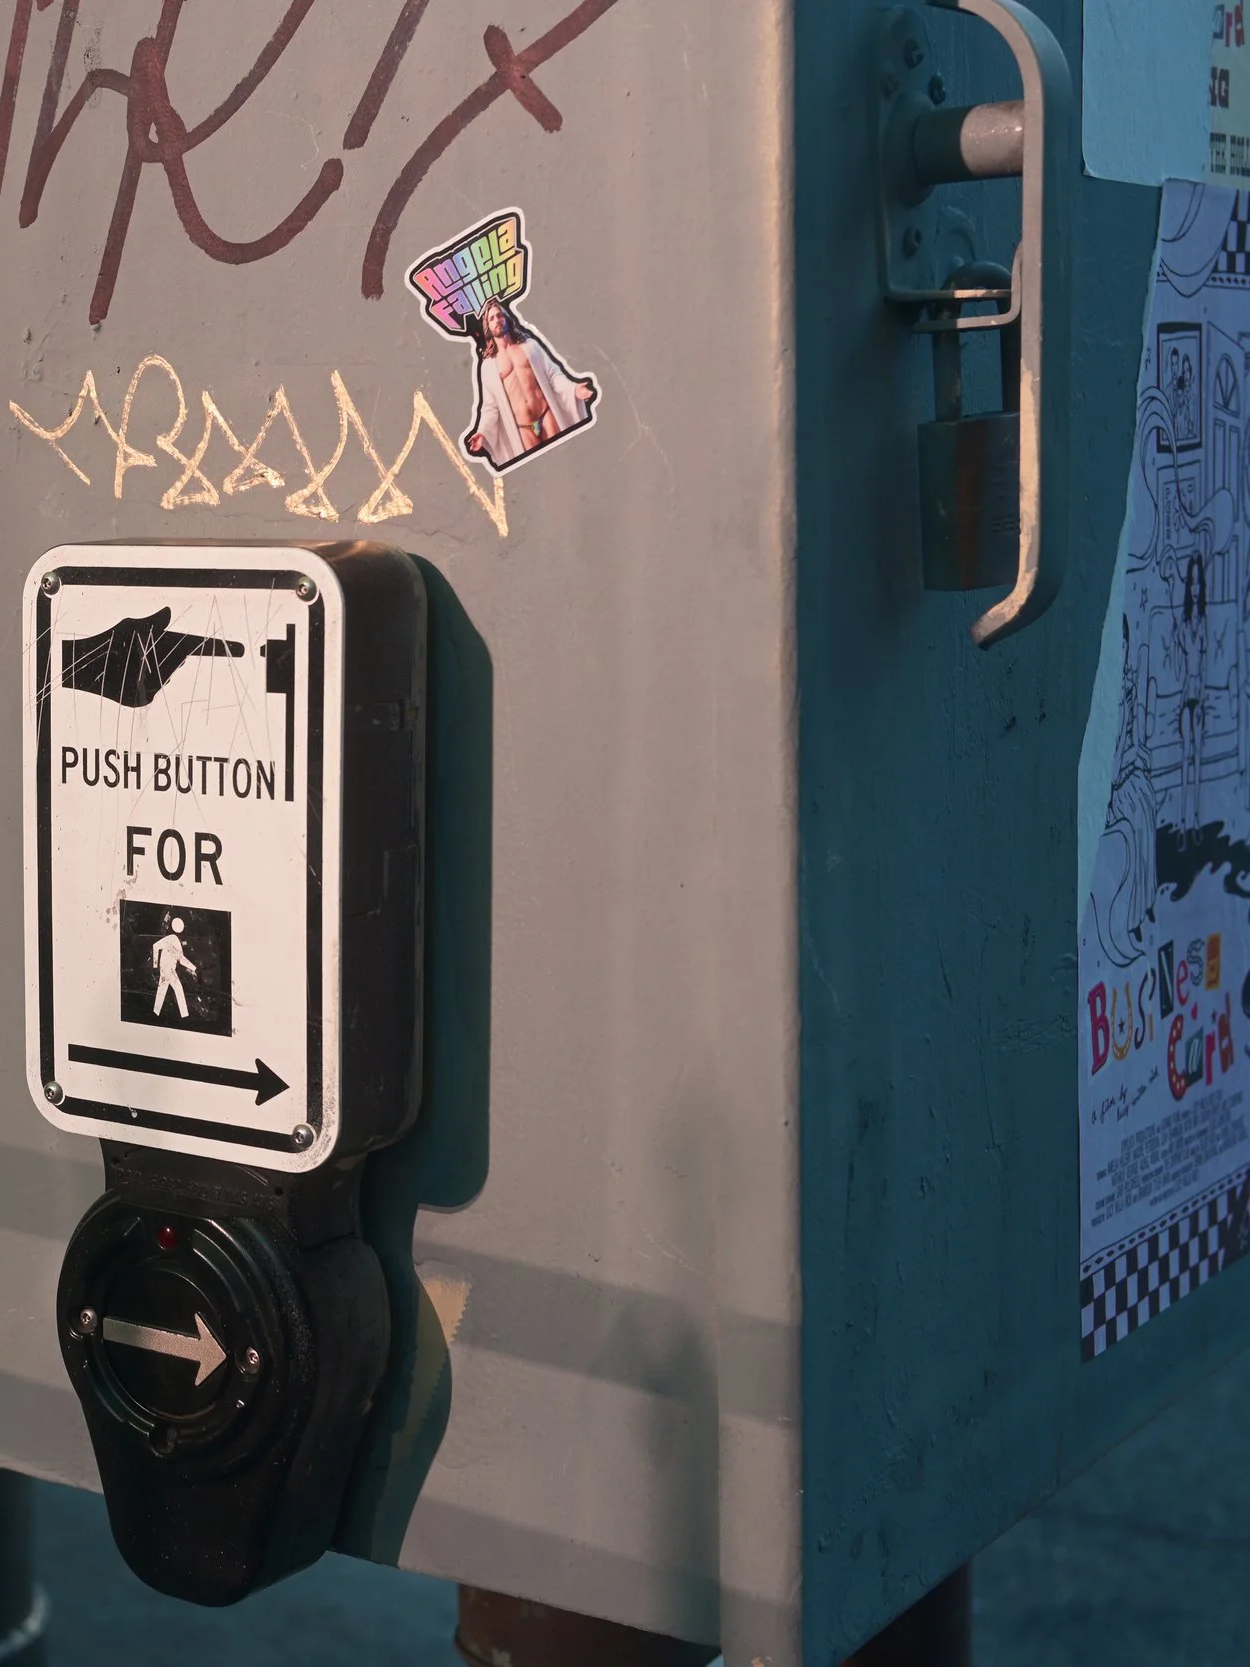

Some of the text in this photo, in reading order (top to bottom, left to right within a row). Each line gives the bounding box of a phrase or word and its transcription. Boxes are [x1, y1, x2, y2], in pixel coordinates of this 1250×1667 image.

[61, 745, 276, 801] PUSH BUTTON
[125, 824, 224, 886] FOR
